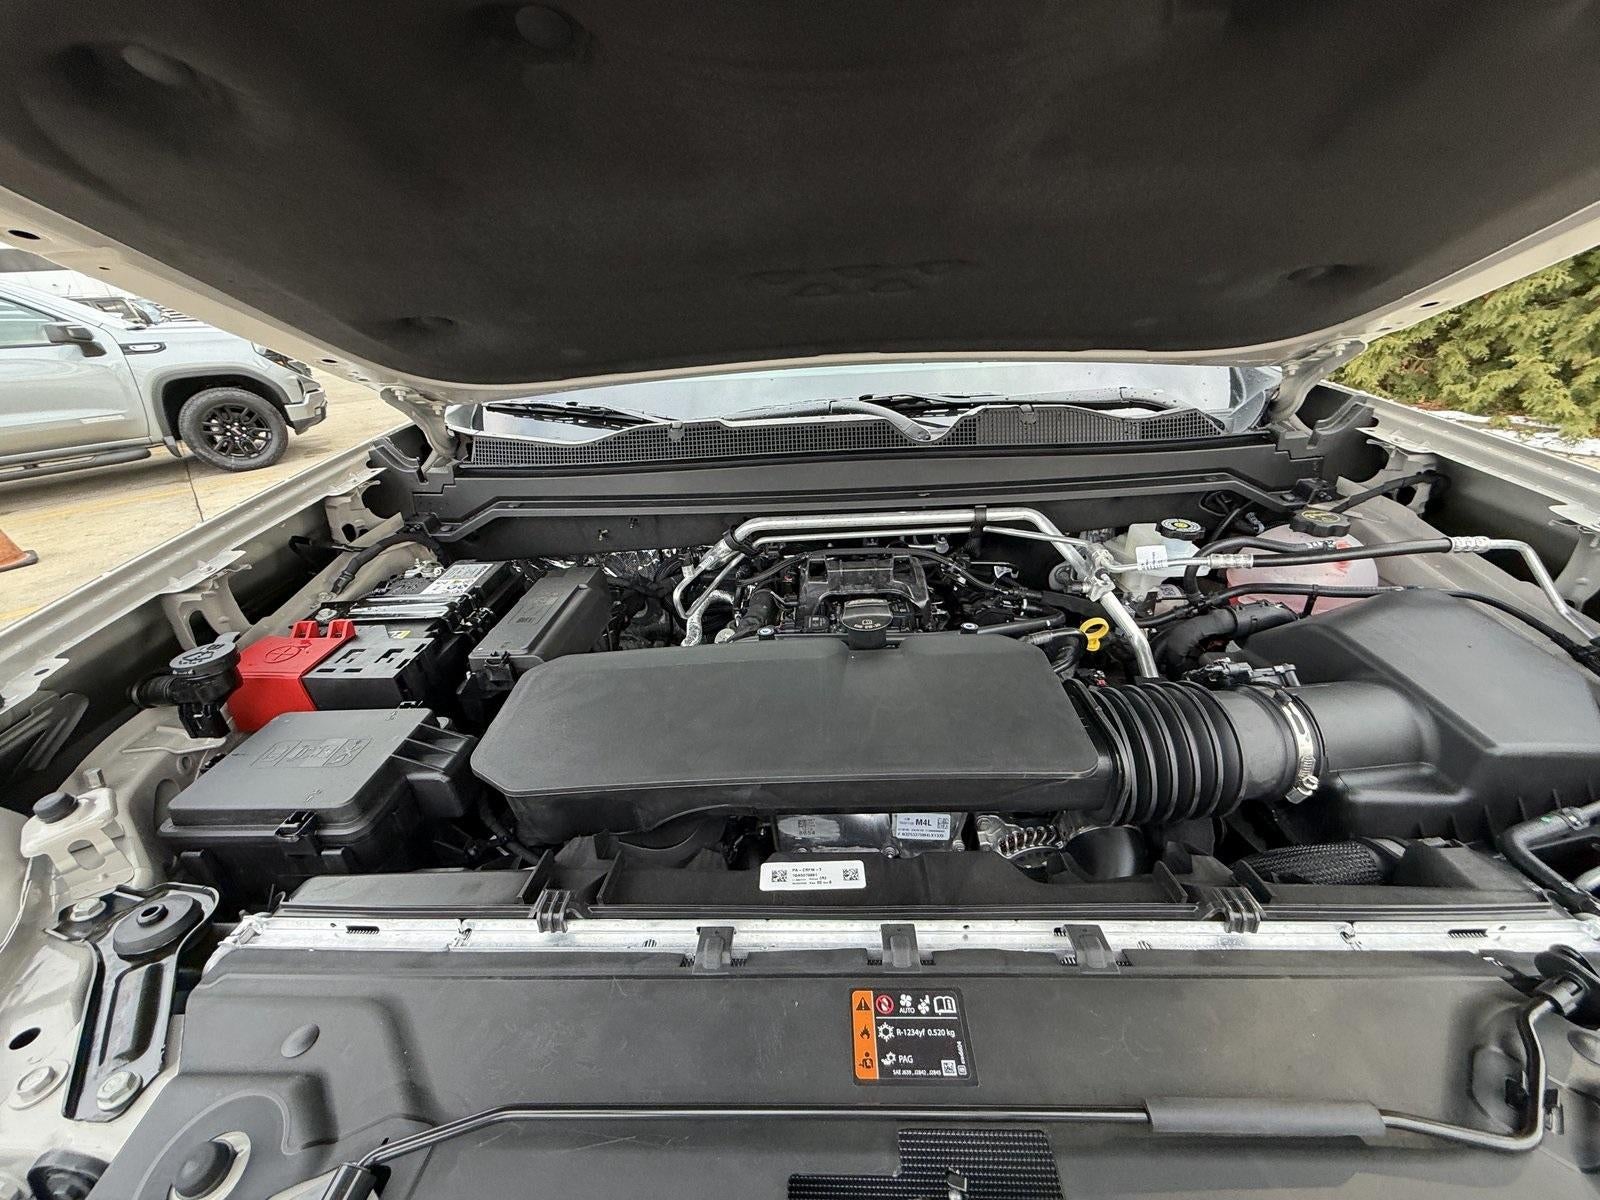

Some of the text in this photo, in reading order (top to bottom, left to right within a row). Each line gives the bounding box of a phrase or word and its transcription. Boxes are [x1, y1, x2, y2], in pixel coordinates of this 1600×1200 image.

[915, 818, 932, 827] M4L
[896, 1028, 956, 1038] R-1234yf 0.520 kg
[898, 1055, 914, 1064] PAG
